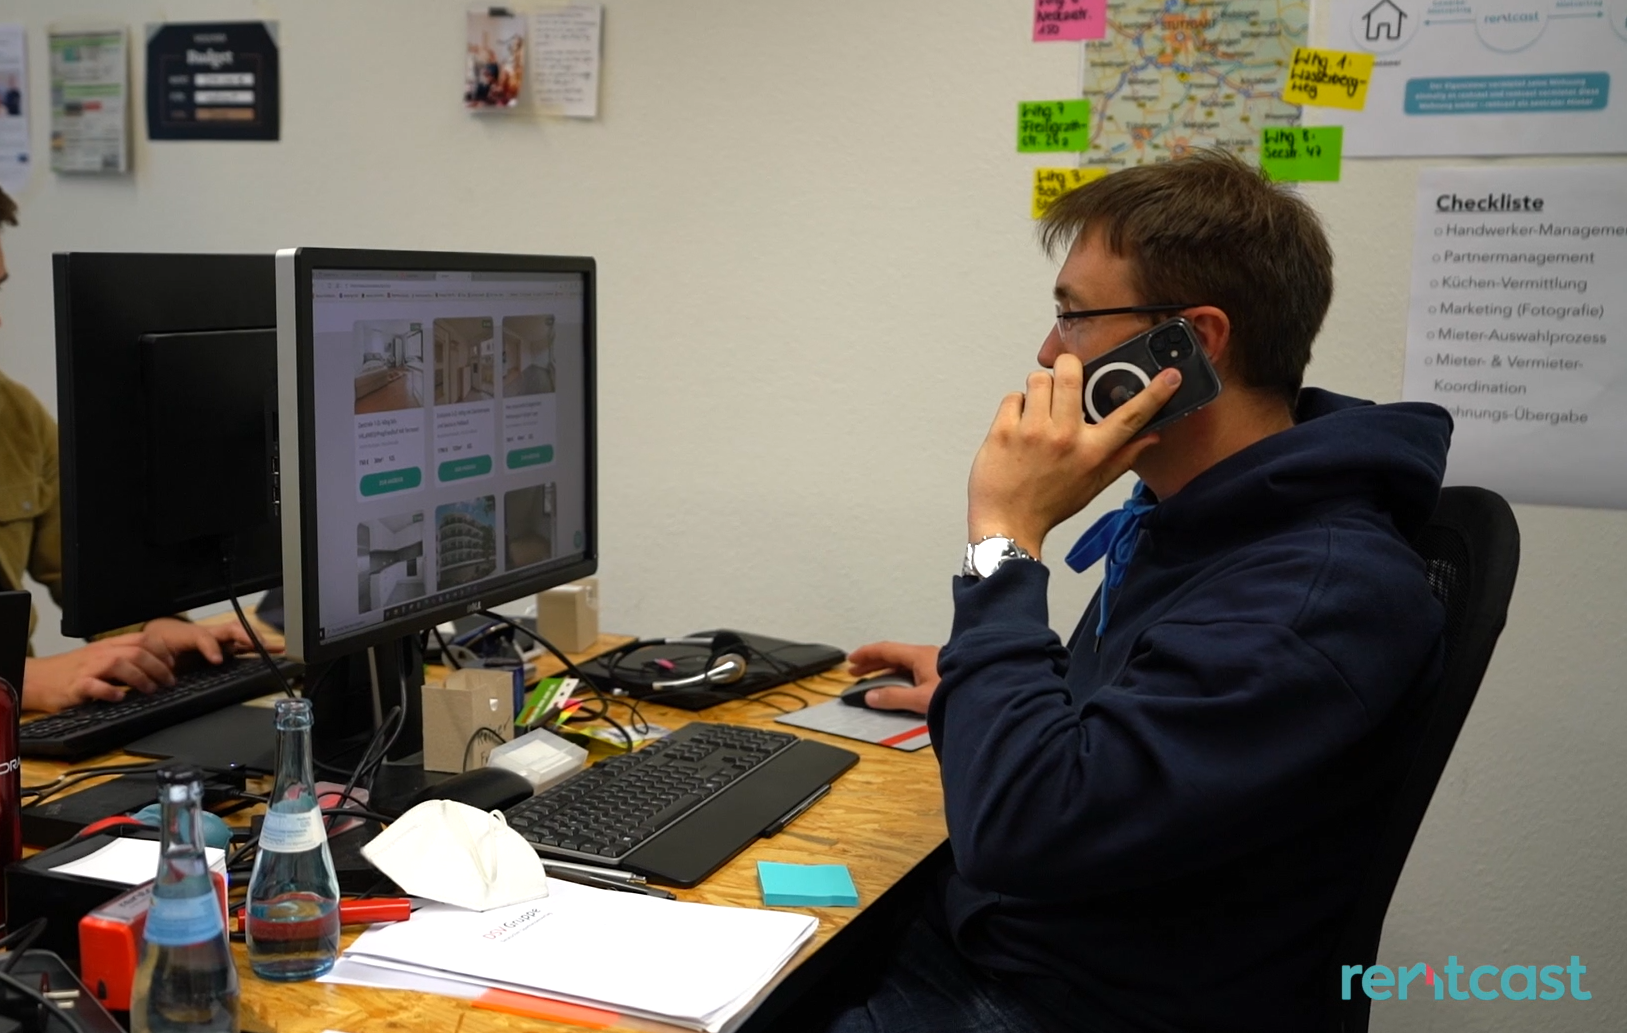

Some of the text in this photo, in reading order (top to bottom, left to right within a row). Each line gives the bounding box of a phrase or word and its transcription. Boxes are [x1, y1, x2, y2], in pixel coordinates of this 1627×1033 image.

[1436, 193, 1544, 212] Checkliste
[1446, 222, 1627, 239] Handwerker-Manageme
[1444, 250, 1595, 267] Partnermanagement
[1442, 275, 1588, 293] Küchen-Vermittlung
[1440, 302, 1605, 320] Marketing (Fotografie)
[1438, 328, 1607, 346] Mieter-Auswahlprozess
[1436, 353, 1584, 370] Mieter- & Vermieter-
[1434, 378, 1527, 395] Koordination
[1449, 405, 1589, 425] ohnungs-Übergabe
